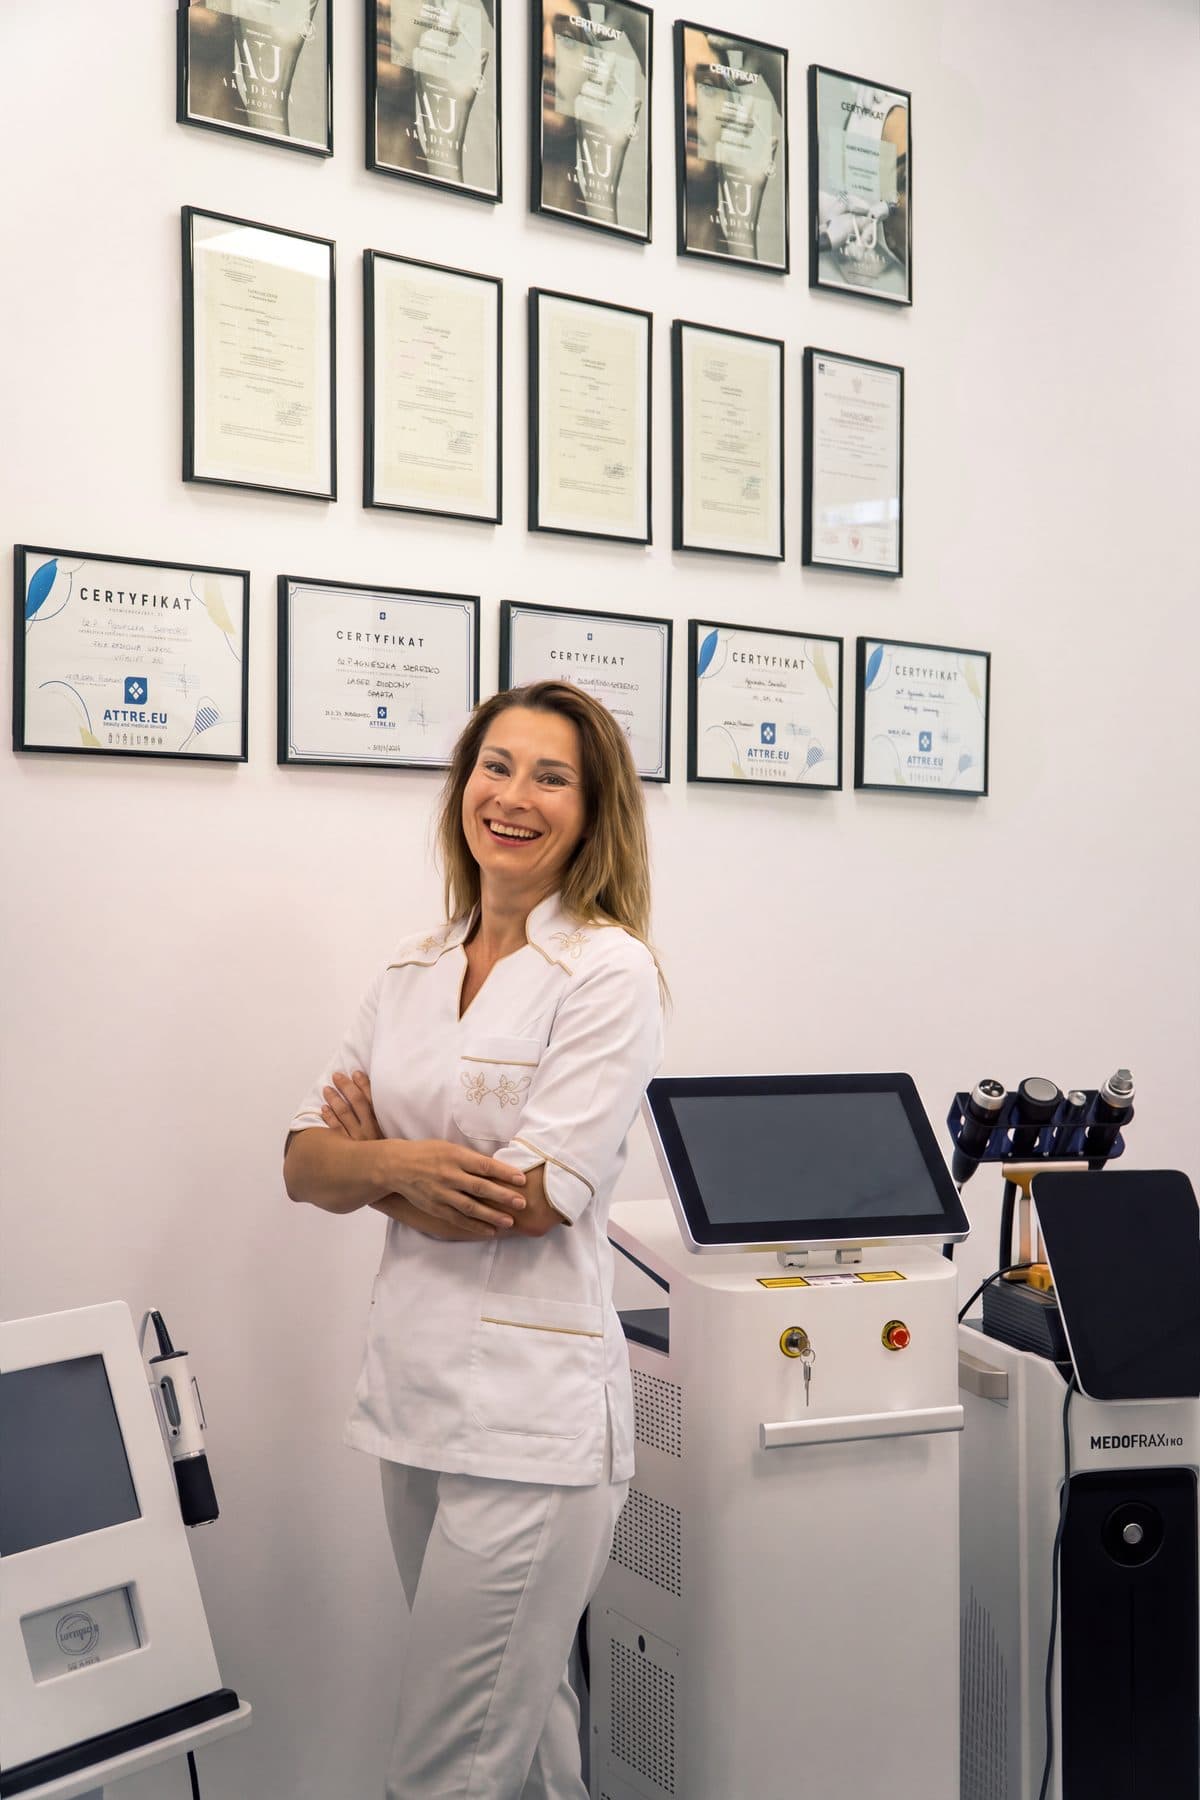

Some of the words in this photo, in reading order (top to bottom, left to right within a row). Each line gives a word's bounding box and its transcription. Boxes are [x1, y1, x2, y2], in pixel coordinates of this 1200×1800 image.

[569, 15, 622, 41] CERTYFIKAT
[232, 39, 281, 84] AJ
[709, 63, 759, 84] CERTYFIKAT
[414, 91, 457, 134] AJ
[841, 102, 884, 121] CERTYFIKAT
[576, 138, 613, 178] AJ
[717, 180, 752, 217] AJ
[80, 587, 192, 610] CERTYFIKAT
[336, 630, 425, 647] CERTYFIKAT
[550, 650, 625, 666] CERTYFIKAT
[733, 652, 805, 670] CERTYFIKAT
[895, 665, 958, 681] CERTYFIKAT
[104, 709, 168, 724] ATTRE.EU
[747, 748, 790, 760] ATTRE.EU
[907, 755, 944, 767] ATTRE.EU
